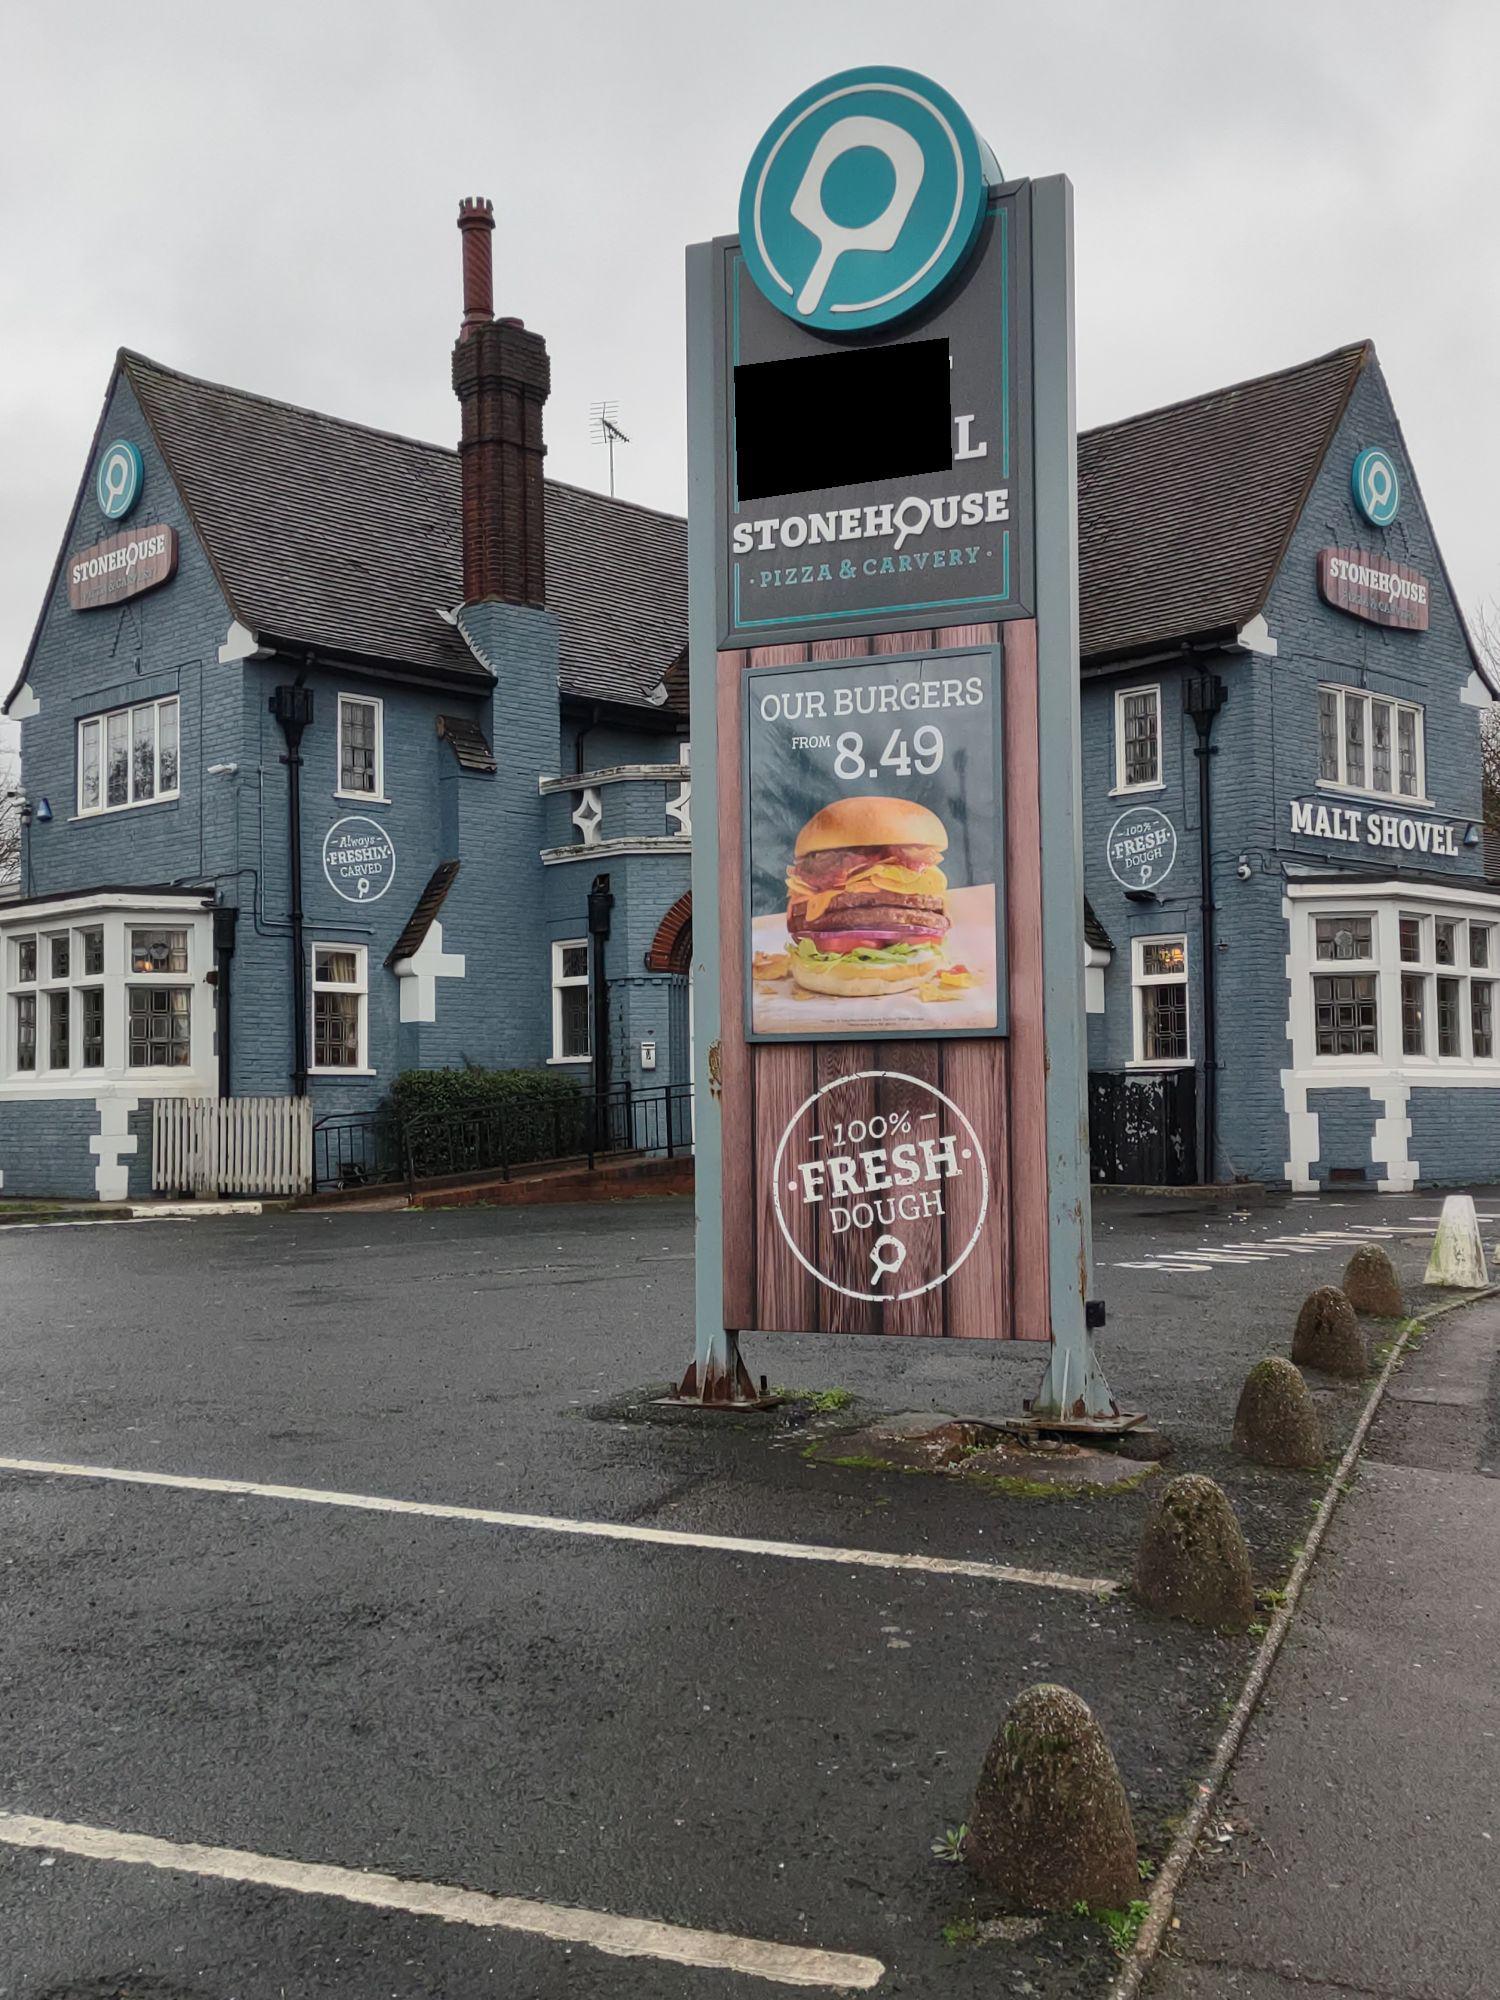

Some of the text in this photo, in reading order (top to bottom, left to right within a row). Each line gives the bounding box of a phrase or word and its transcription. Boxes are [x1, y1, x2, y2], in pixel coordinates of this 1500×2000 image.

[733, 489, 1009, 554] STONEHOUSE
[72, 534, 166, 584] STONEHOUSE
[760, 546, 981, 587] PIZZA & CARVERY
[1330, 557, 1427, 604] STONEHOUSE
[760, 677, 984, 722] OUR BURGERS
[791, 725, 945, 780] FROM 8.49
[340, 835, 375, 848] Always
[1114, 828, 1168, 859] FRESH
[1123, 822, 1152, 836] 100%
[1290, 801, 1459, 856] MALT SHOVEL
[329, 845, 389, 865] FRESHLY
[340, 863, 382, 877] CARVED
[1125, 847, 1163, 868] DOUGH
[833, 1110, 911, 1147] 100%
[798, 1135, 963, 1203] FRESH
[829, 1190, 945, 1233] DOUGH
